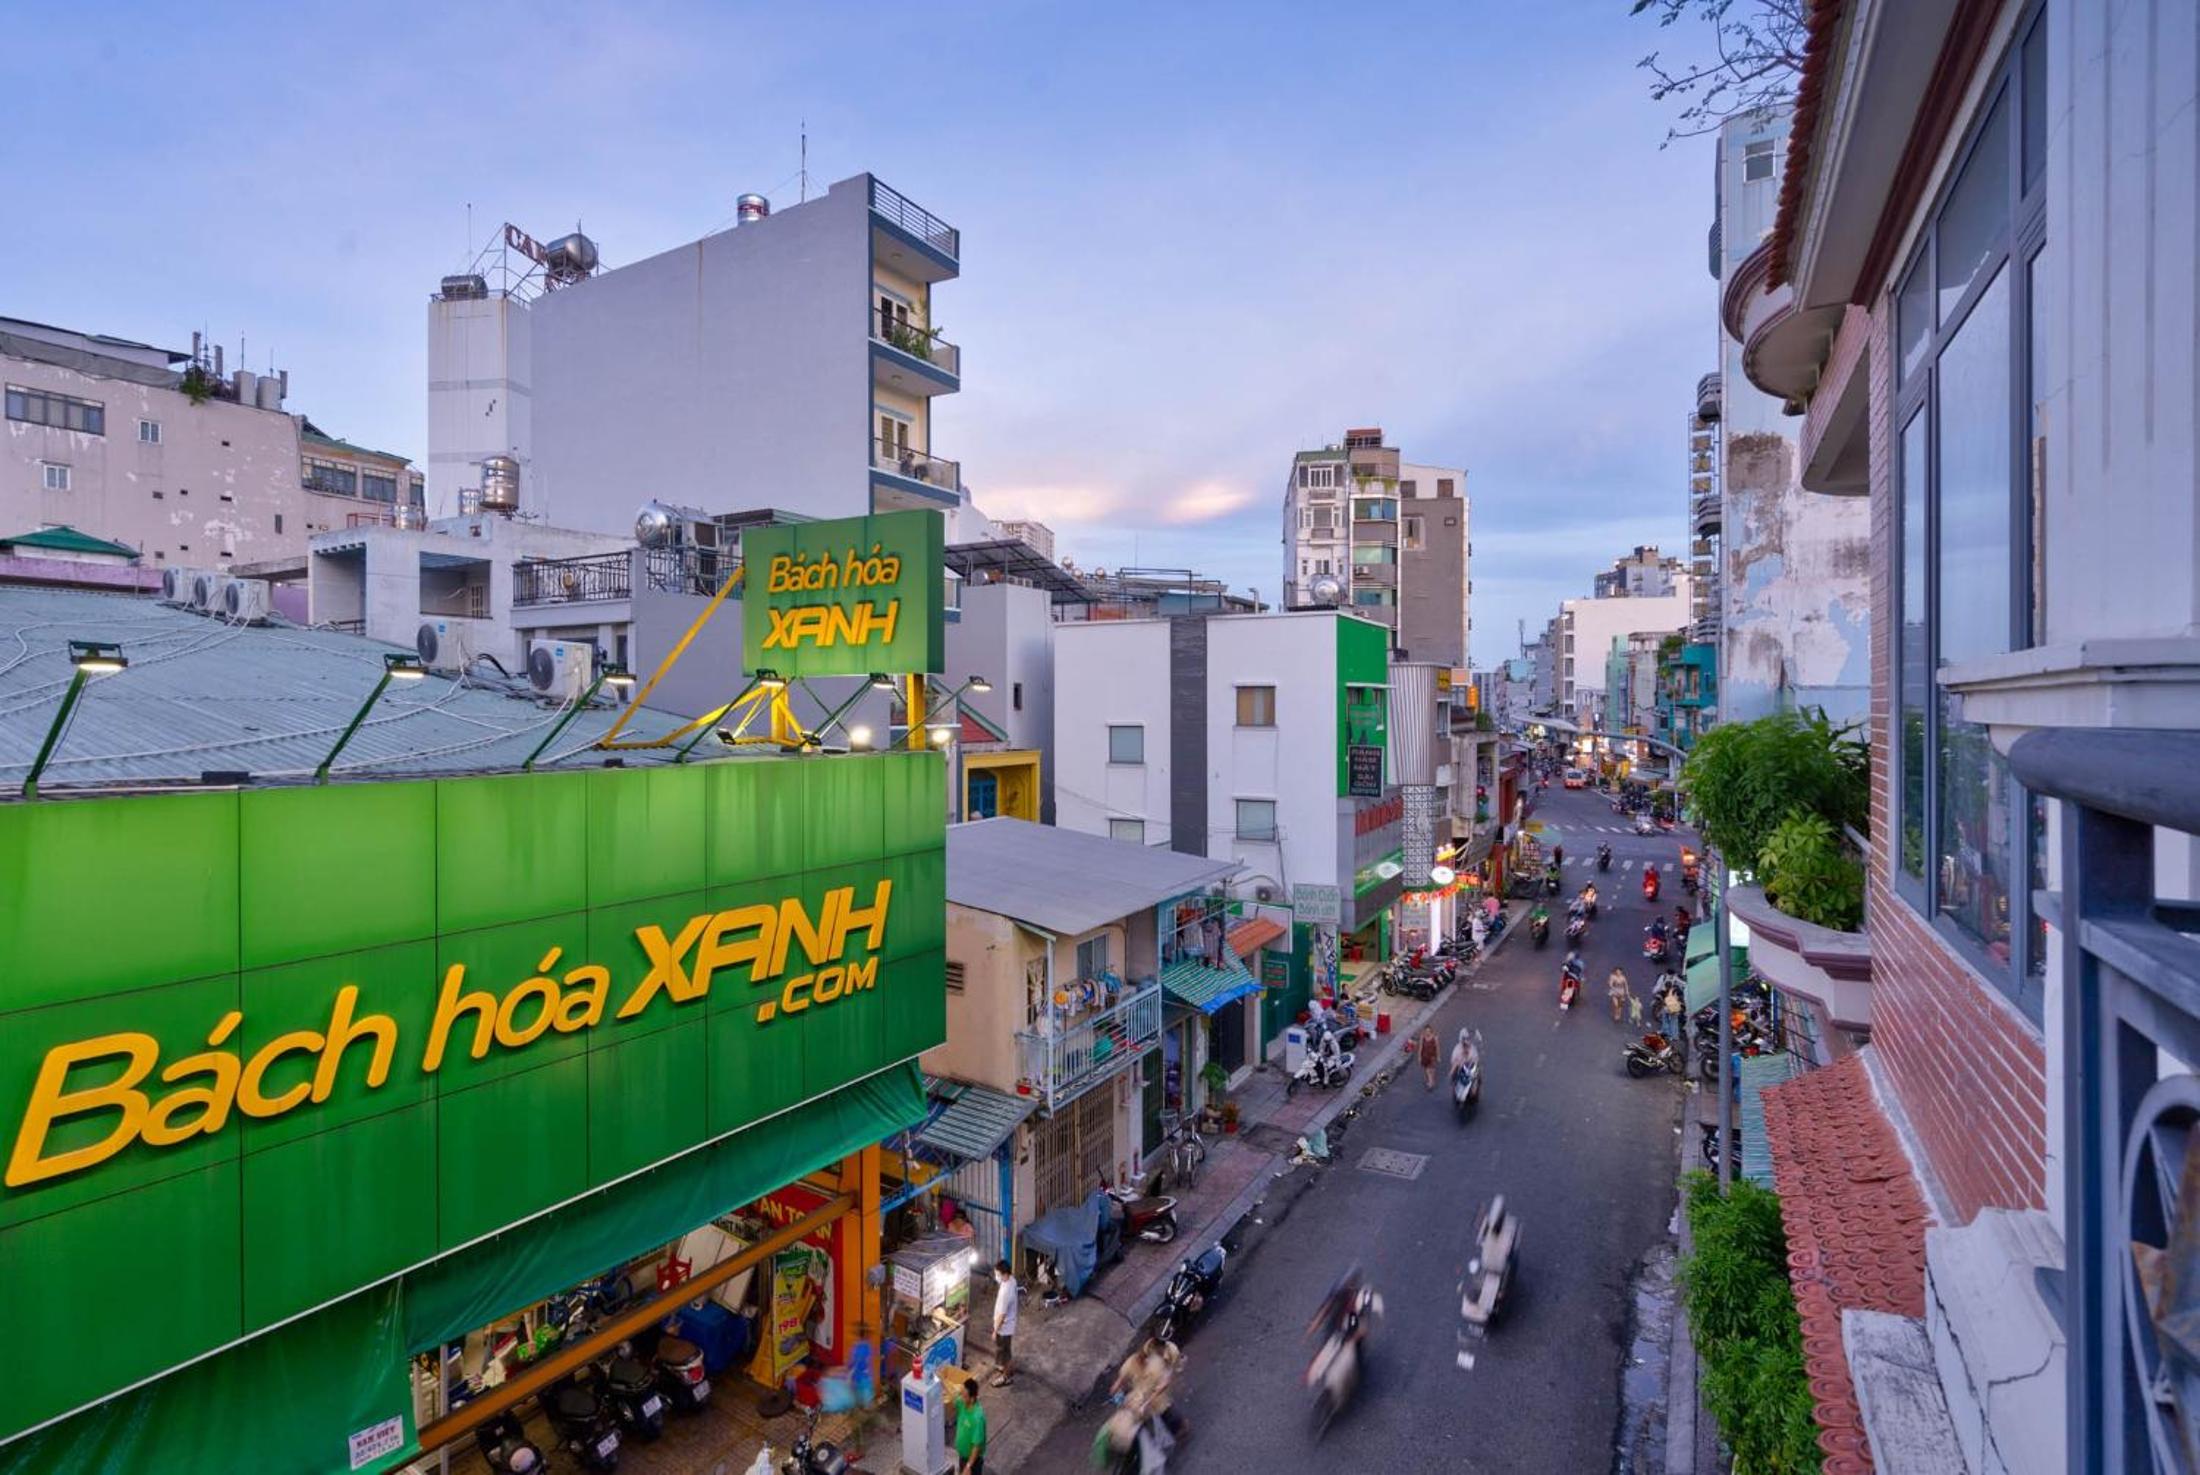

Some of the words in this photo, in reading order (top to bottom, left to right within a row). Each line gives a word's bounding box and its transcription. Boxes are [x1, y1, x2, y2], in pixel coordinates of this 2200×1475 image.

[768, 552, 838, 593] Bách
[843, 543, 900, 587] hóa
[761, 601, 899, 649] XANH
[757, 957, 878, 1022] .COM
[5, 985, 397, 1187] Bách
[422, 946, 610, 1072] hóa
[616, 880, 892, 1018] XANH
